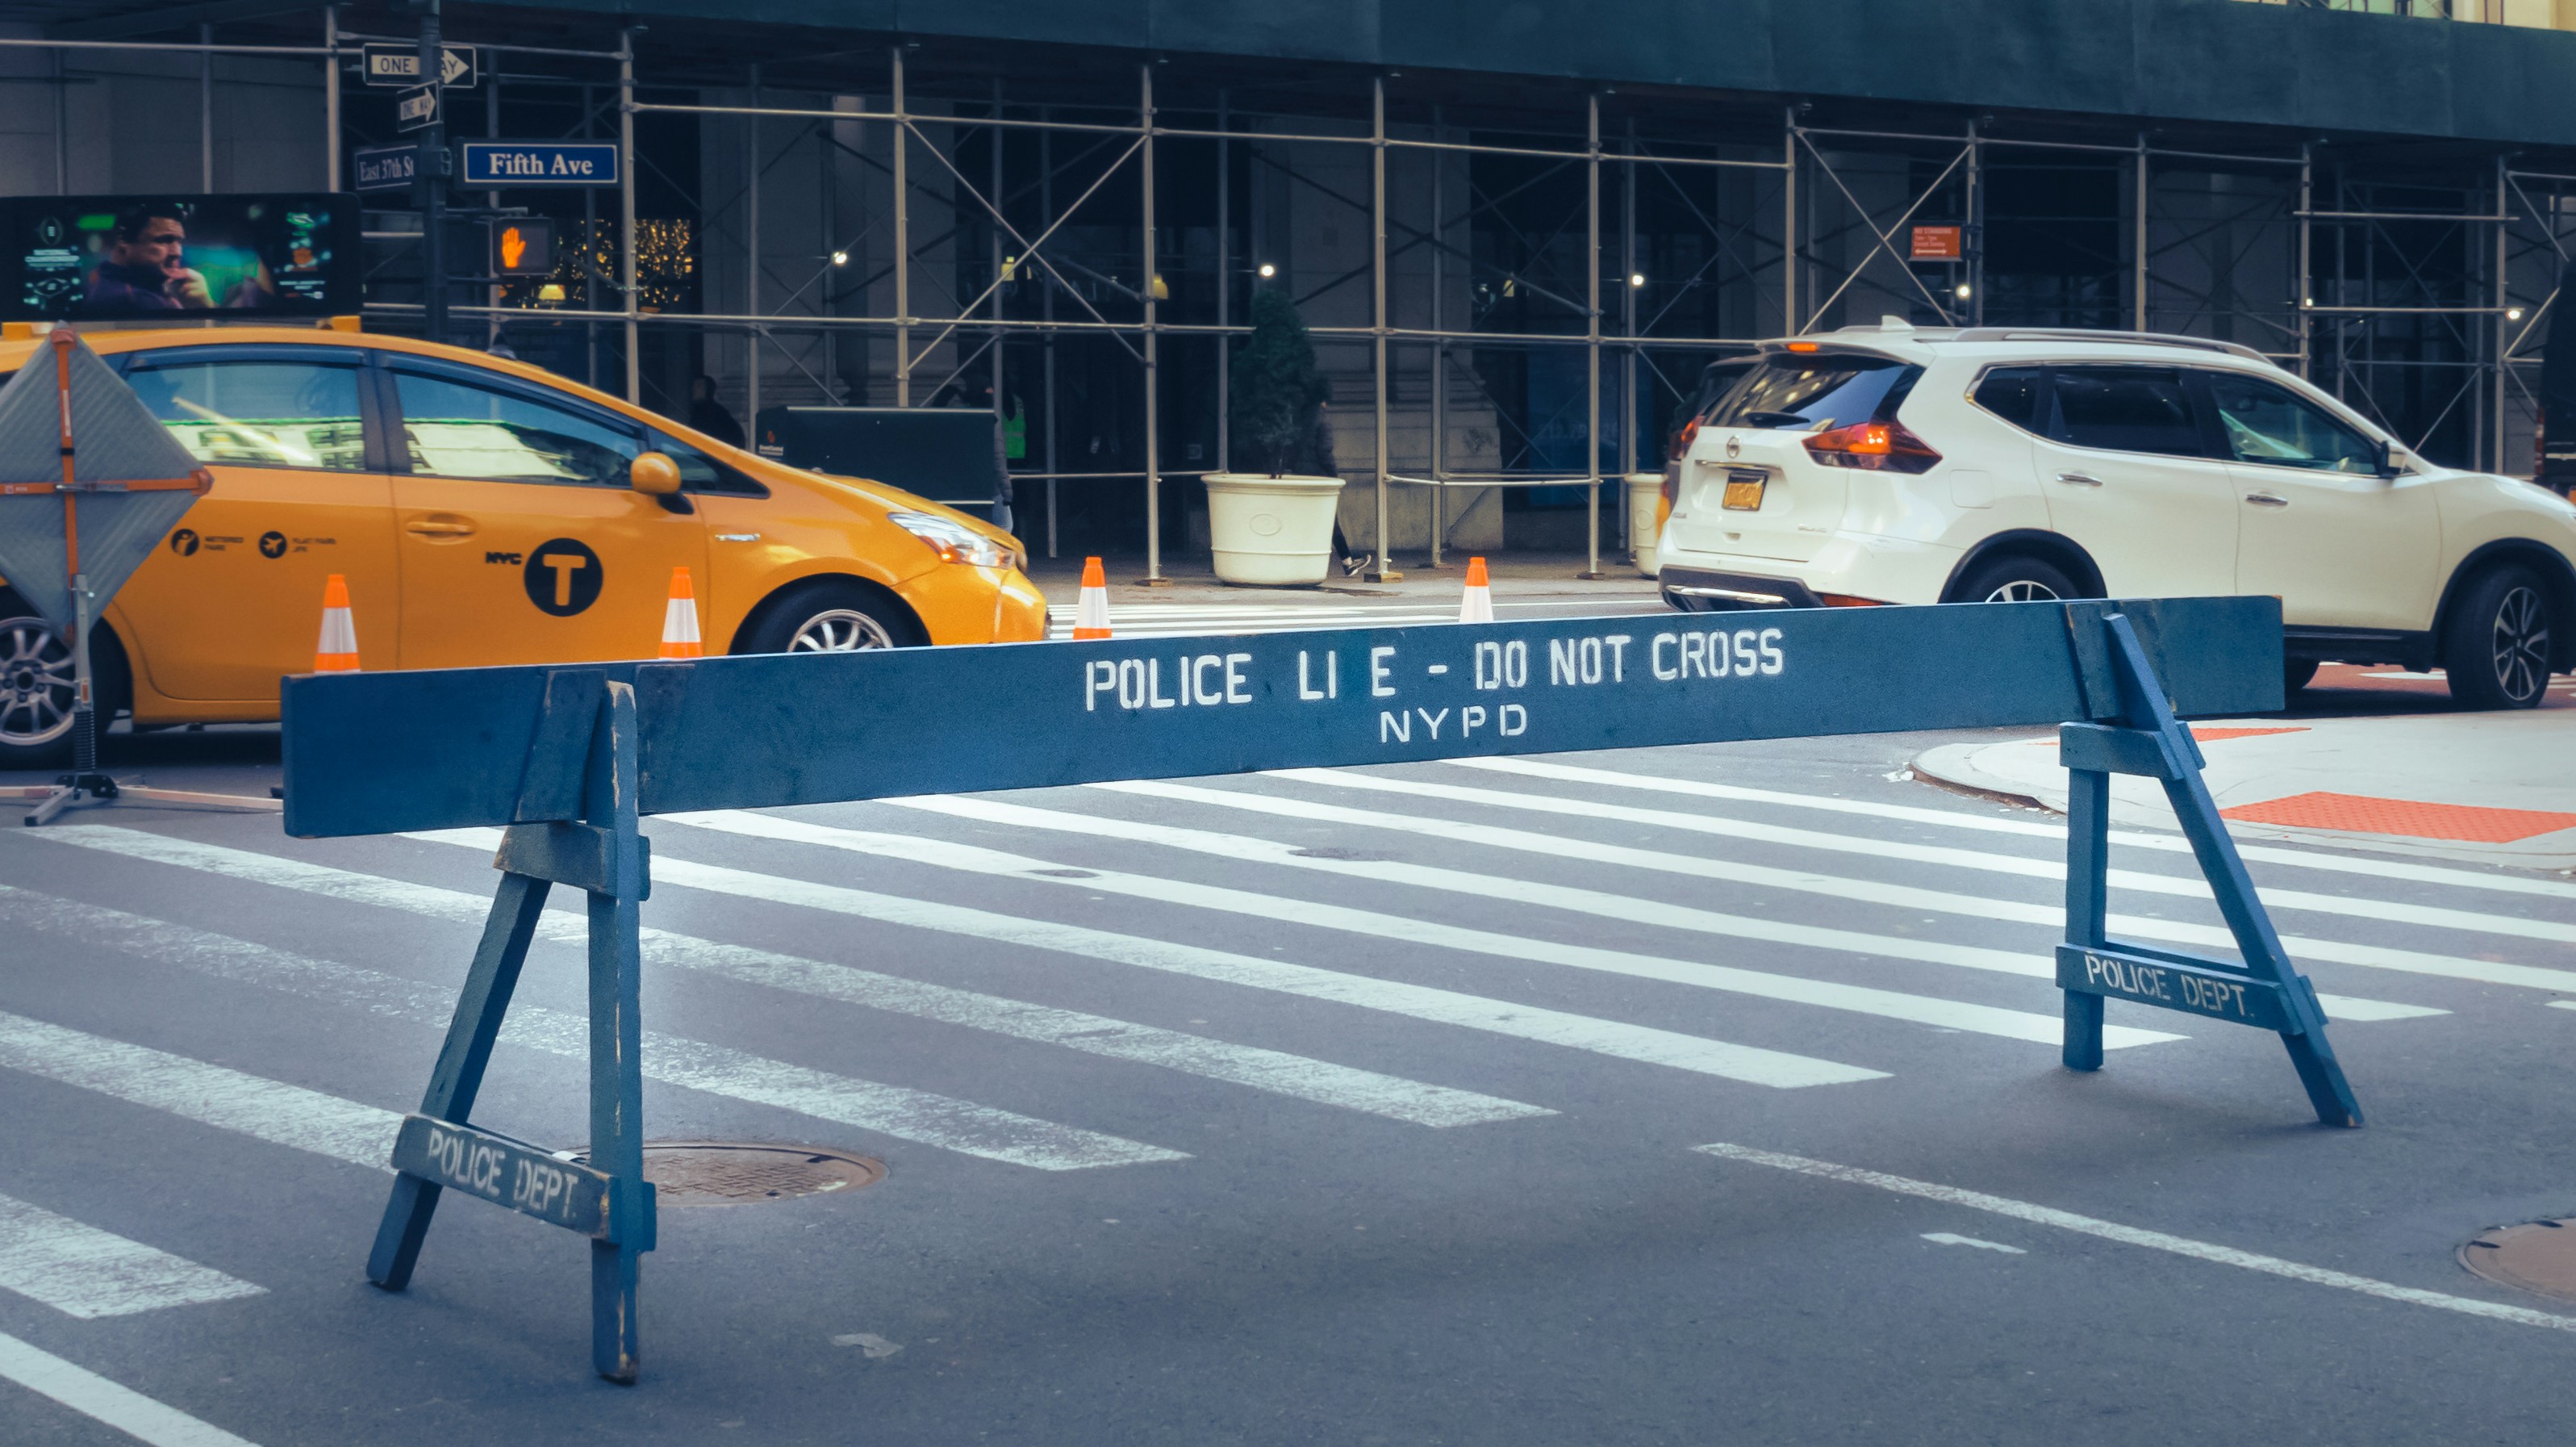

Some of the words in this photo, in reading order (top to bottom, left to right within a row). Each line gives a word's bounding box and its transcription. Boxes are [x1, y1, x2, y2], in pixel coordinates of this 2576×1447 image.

[381, 57, 411, 73] ONE
[440, 60, 458, 74] AY
[404, 102, 414, 118] ONE
[420, 99, 432, 114] WAY
[359, 161, 380, 182] East
[382, 158, 402, 179] 37th
[403, 155, 414, 177] St
[489, 153, 545, 175] Fifth
[551, 153, 593, 175] Ave
[486, 552, 523, 565] NYC
[544, 554, 587, 607] T
[1086, 653, 1253, 711] POLICE
[1299, 646, 1396, 700] LIE
[1476, 641, 1528, 689] DO
[1550, 635, 1631, 685] NOT
[1651, 629, 1785, 680] CROSS
[1380, 704, 1528, 742] NYPD
[2084, 951, 2171, 1001] POLICE
[428, 1127, 506, 1197] POLICE
